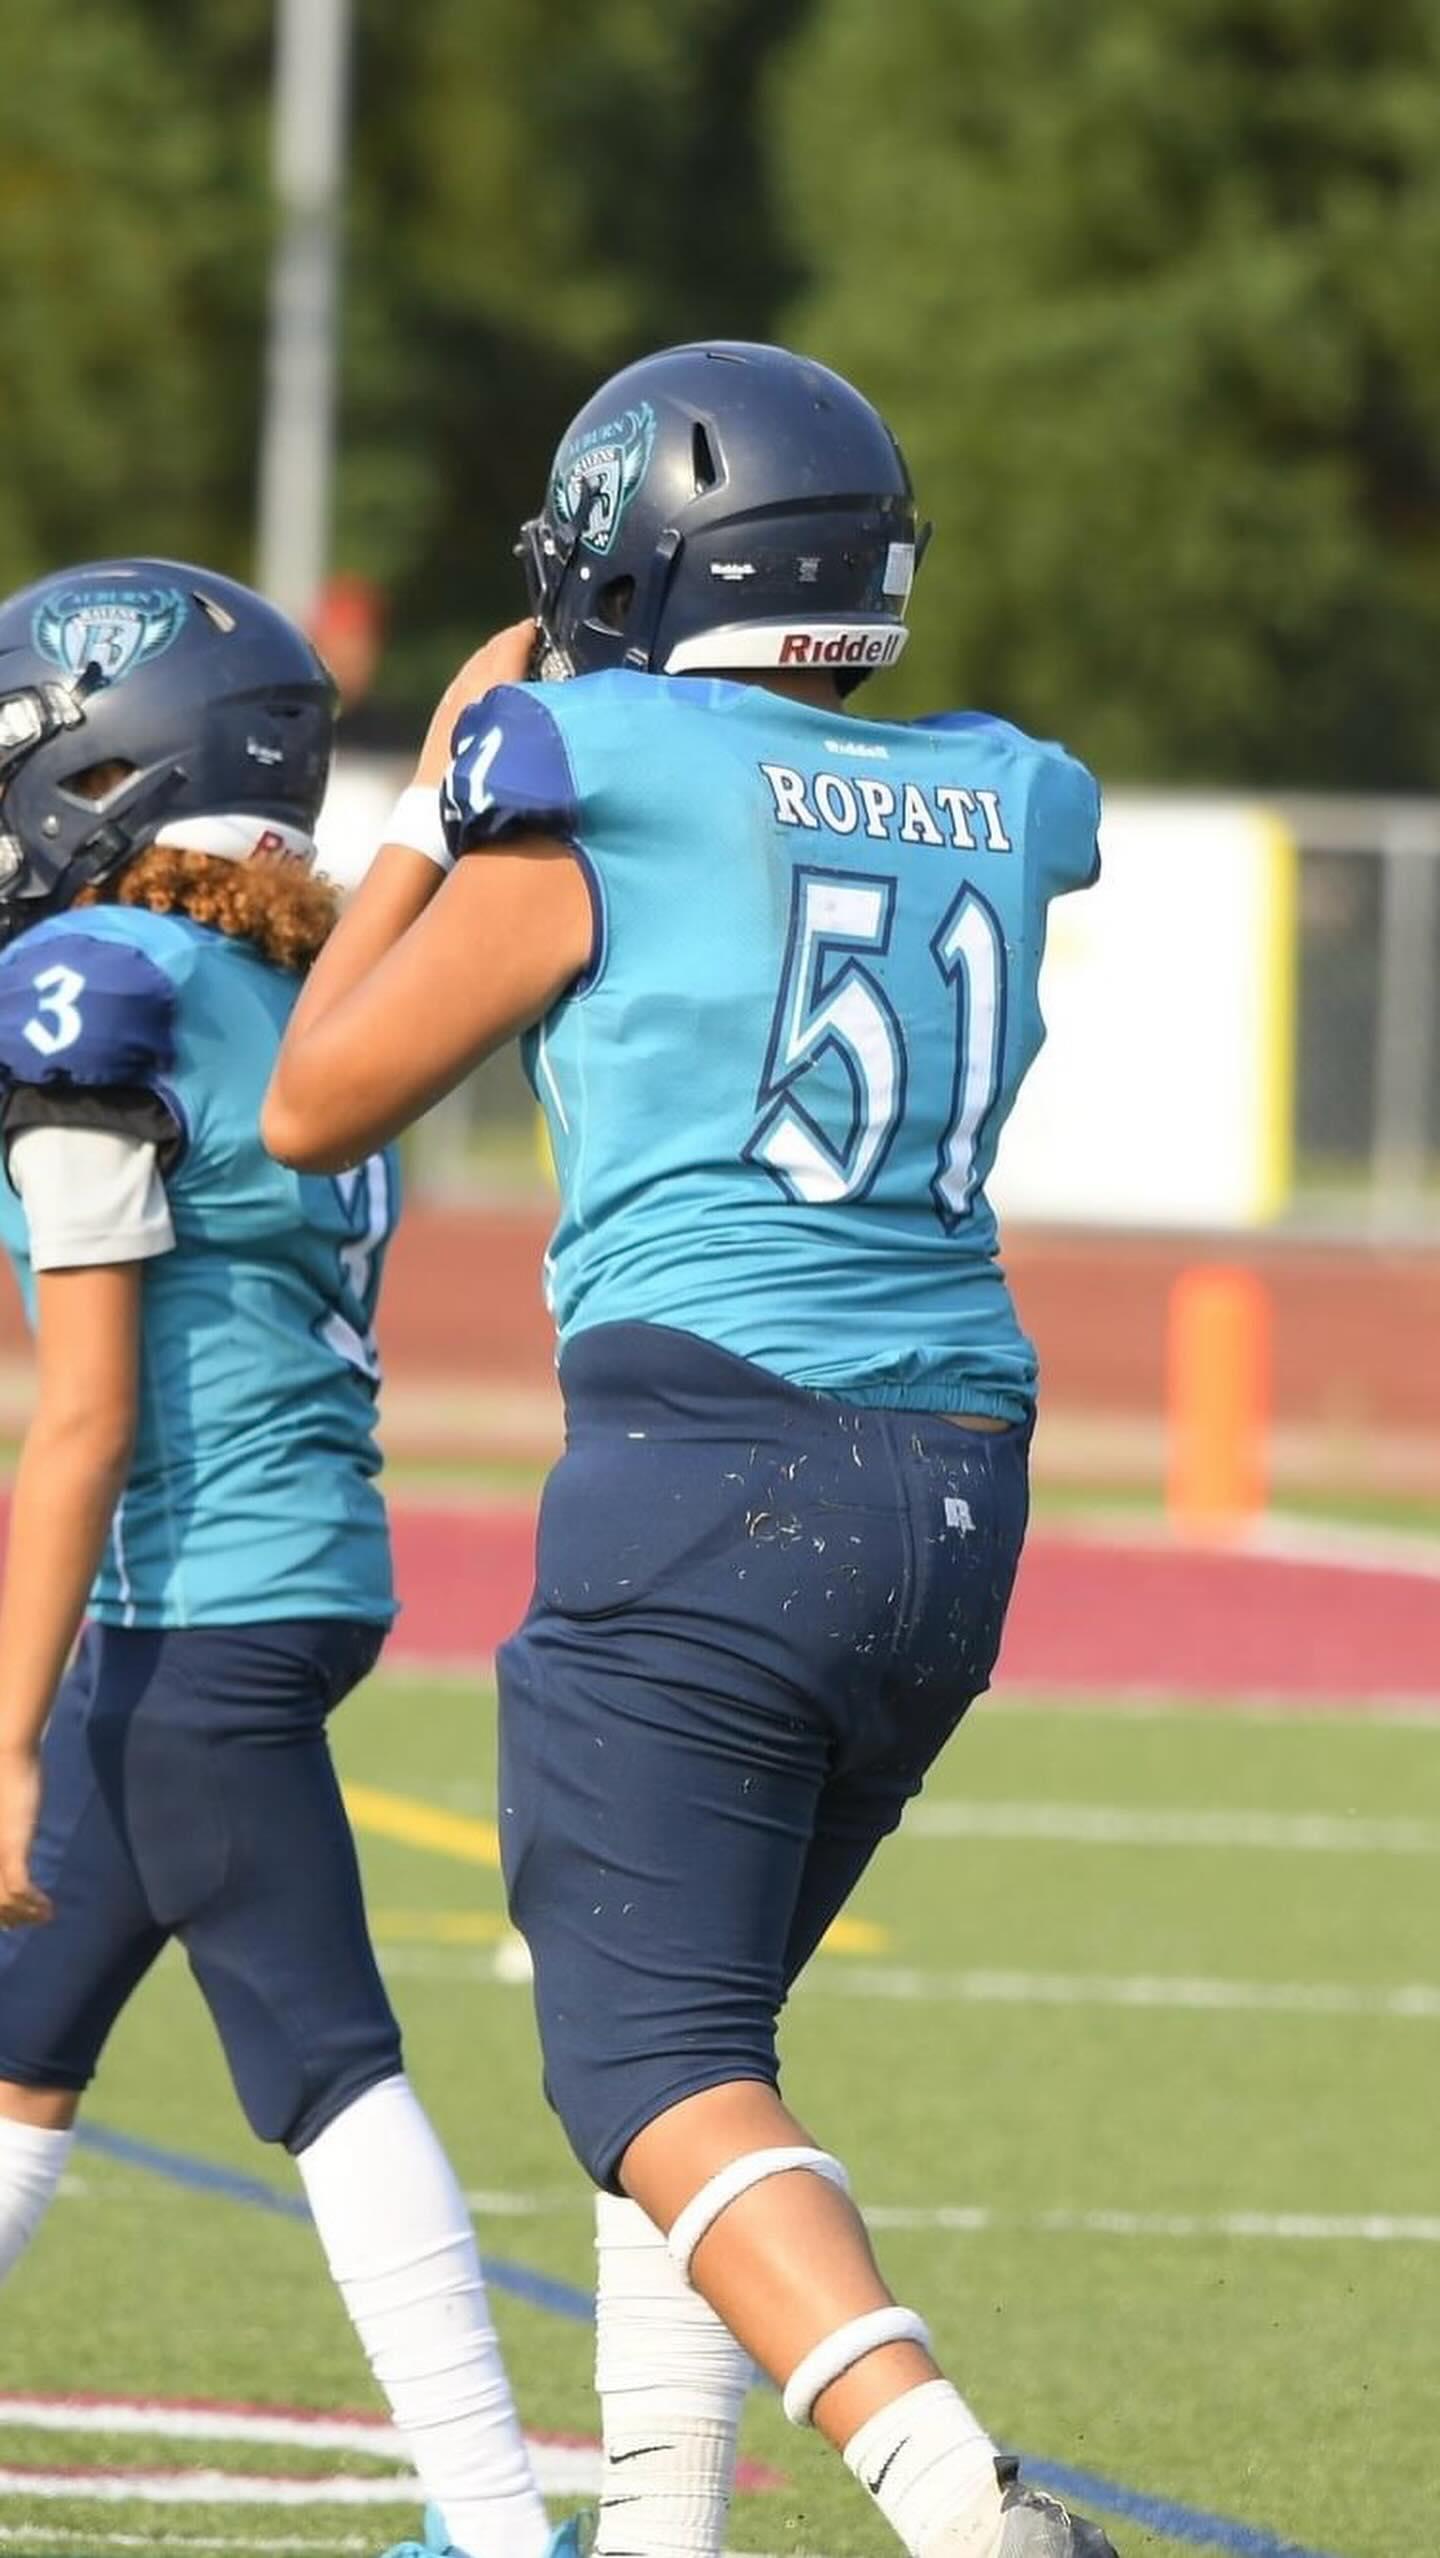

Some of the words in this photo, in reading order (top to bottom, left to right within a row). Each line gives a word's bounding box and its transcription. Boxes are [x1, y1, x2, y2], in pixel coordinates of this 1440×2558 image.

[778, 633, 900, 663] Riddell
[758, 762, 1012, 854] ROPATI
[22, 964, 86, 1057] 3
[740, 864, 1007, 1236] 51
